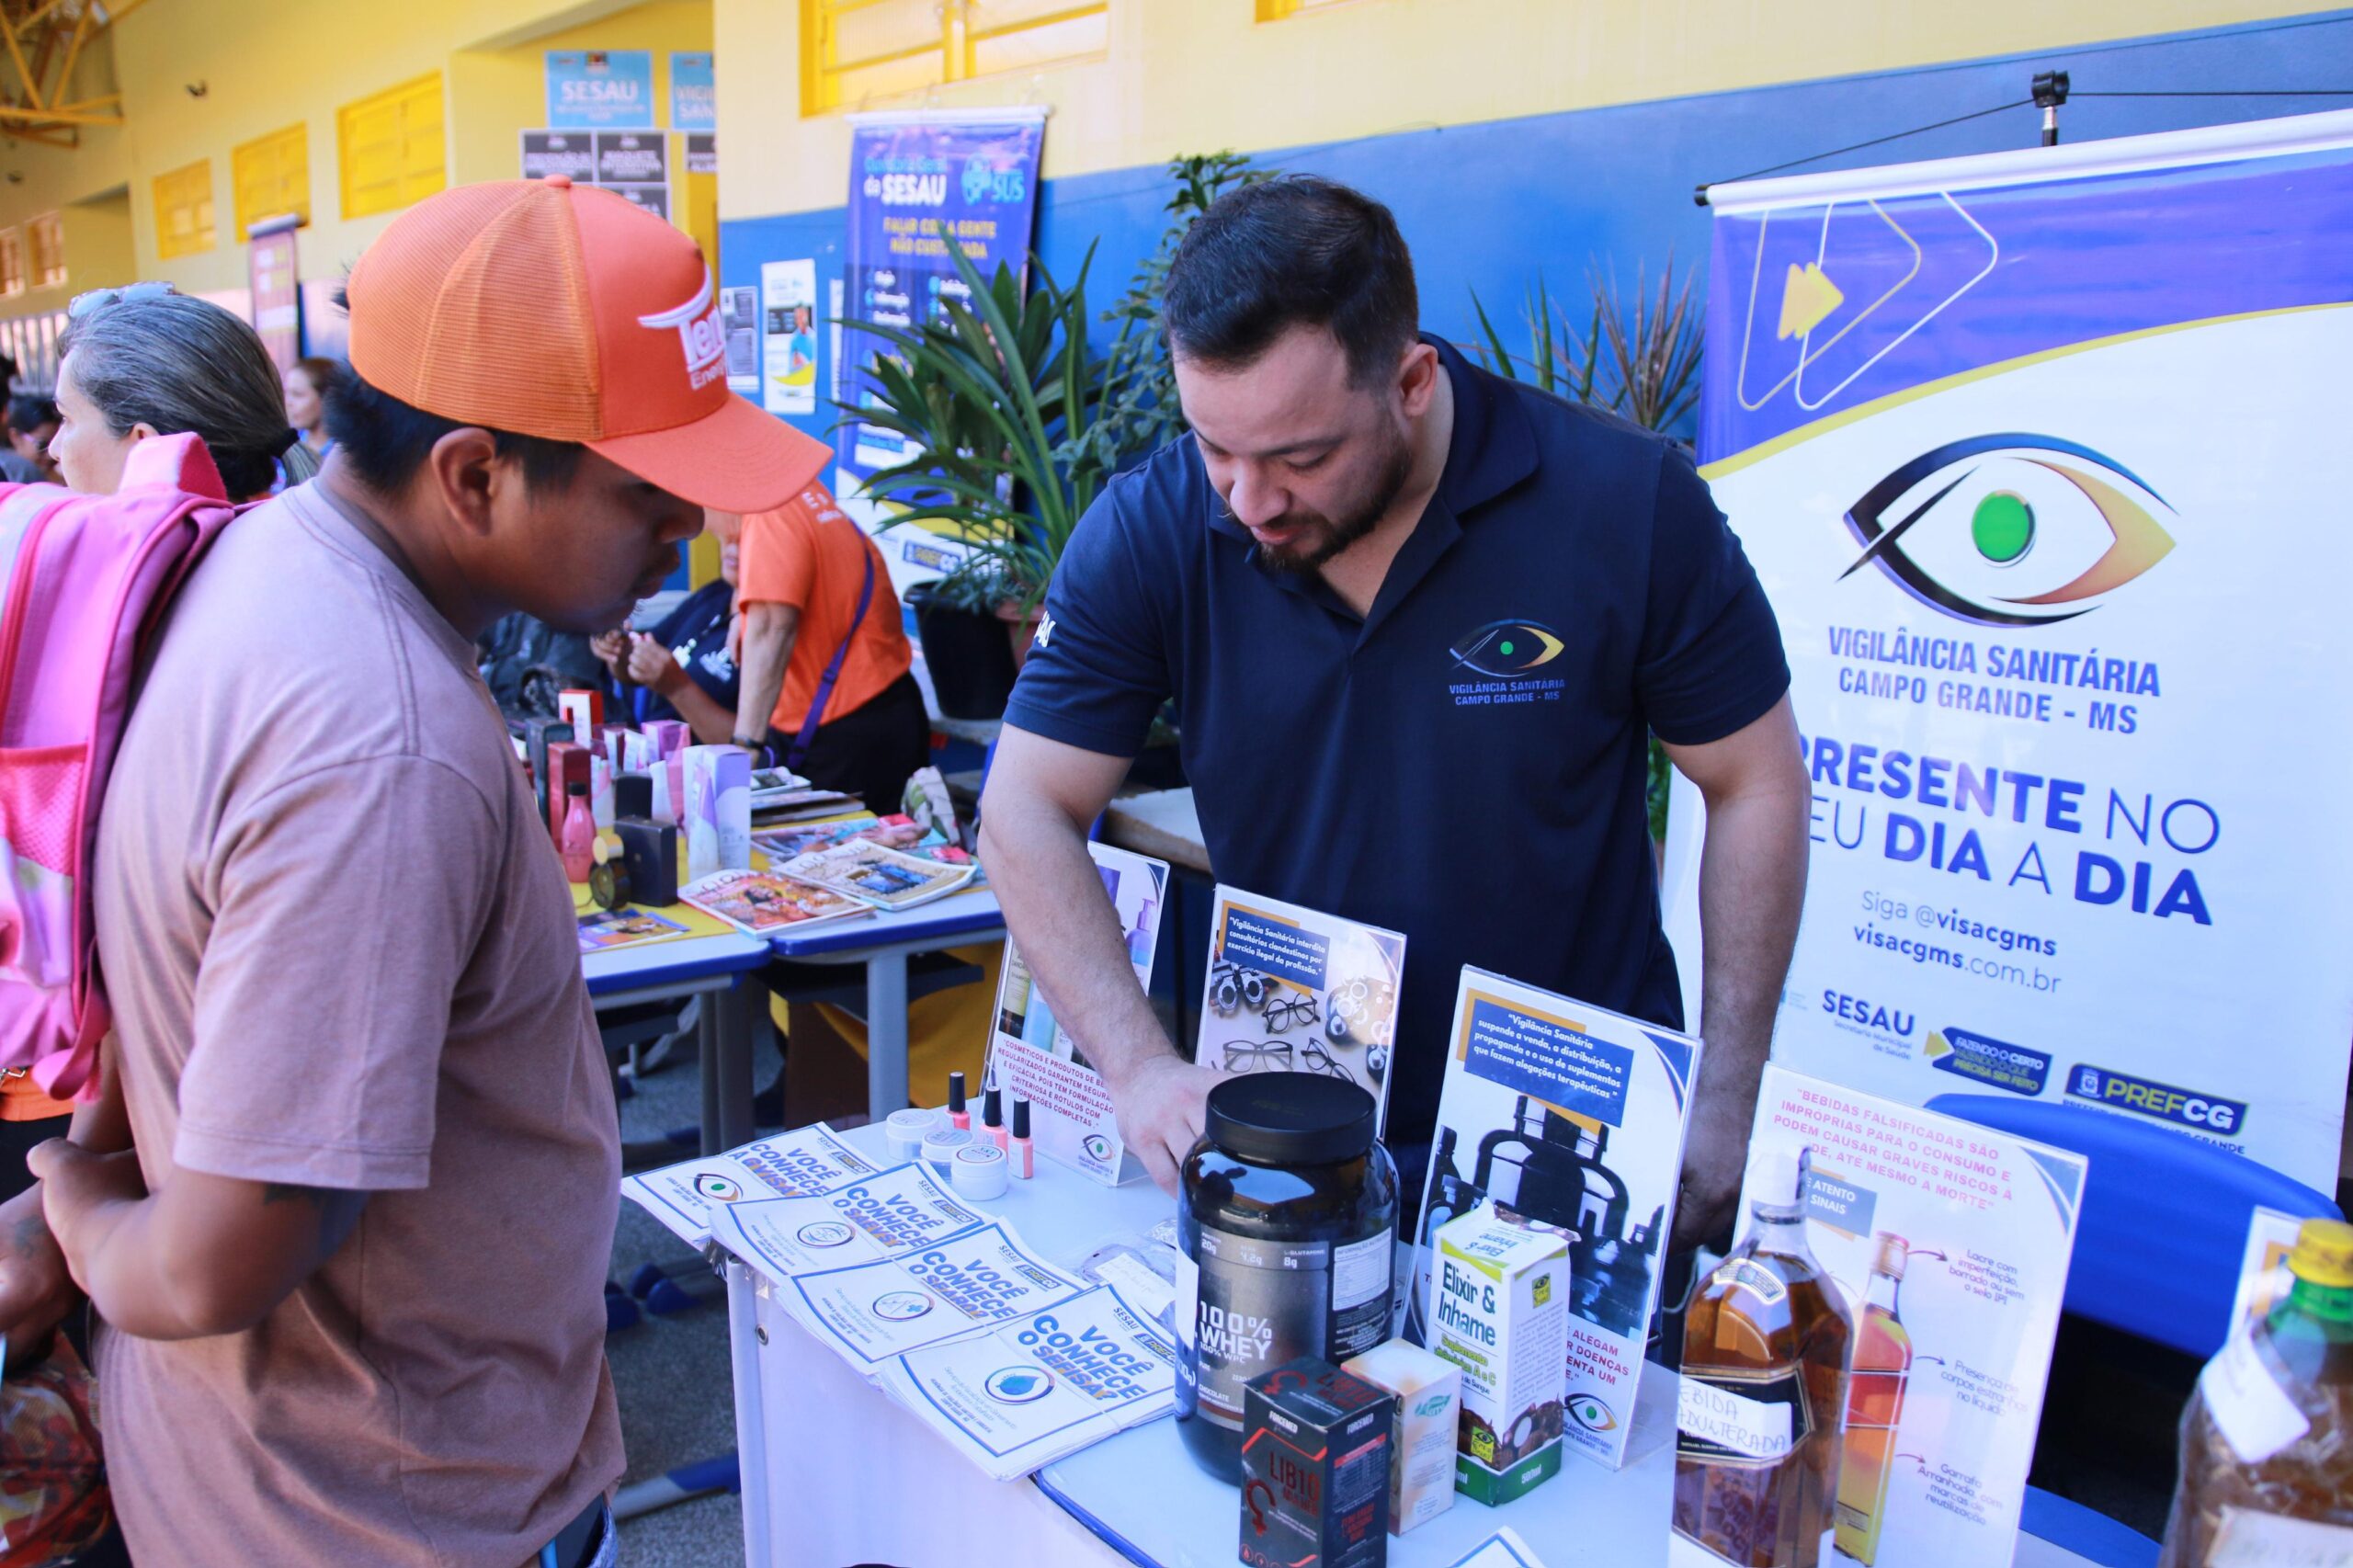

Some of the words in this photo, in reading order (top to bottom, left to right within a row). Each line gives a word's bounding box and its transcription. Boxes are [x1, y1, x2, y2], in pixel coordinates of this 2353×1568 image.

[562, 80, 638, 101] SESAU
[864, 176, 881, 197] da
[881, 174, 947, 206] SESAU
[957, 221, 996, 237] GENTE
[1829, 626, 1978, 675] VIGILÂNCIA
[1987, 644, 2161, 698] SANITÁRIA
[1449, 681, 1506, 694] VIGILÂNCIA
[1510, 678, 1565, 691] SANITÁRIA
[1455, 696, 1490, 705] CAMPO
[1494, 693, 1533, 702] GRANDE
[1544, 691, 1560, 700] MS
[1839, 667, 1927, 704] CAMPO
[1938, 681, 2052, 722] GRANDE
[2088, 701, 2138, 734] MS
[2107, 789, 2220, 854] NO
[1884, 812, 1991, 881] DIA
[2008, 841, 2052, 895] A
[2075, 851, 2212, 926] DIA
[1862, 891, 1907, 920] Siga
[1916, 905, 2057, 956] @visacgms
[1227, 941, 1255, 955] exercício
[1256, 949, 1275, 961] ilegal
[1276, 955, 1284, 964] da
[1230, 931, 1267, 948] consultórios
[1268, 941, 1309, 960] clandestinos
[1265, 928, 1295, 944] Sanitária
[1297, 937, 1325, 953] interdita
[1854, 923, 2062, 993] visacgms.com.br
[1822, 990, 1915, 1037] SESAU
[1478, 1019, 1515, 1038] suspende
[1523, 1034, 1551, 1050] venda,
[1561, 1046, 1613, 1072] distribuição,
[1554, 1029, 1593, 1050] Sanitária
[1834, 1019, 1871, 1038] Secretaria
[1873, 1030, 1912, 1050] Municipal
[1474, 1032, 1523, 1054] propaganda
[1540, 1054, 1553, 1064] uso
[1555, 1059, 1565, 1069] de
[1568, 1063, 1621, 1088] suplementos
[1474, 1046, 1488, 1055] que
[1490, 1049, 1515, 1064] fazem
[1516, 1059, 1556, 1080] alegações
[1885, 1046, 1911, 1060] Saúde
[2010, 1052, 2044, 1070] CERTO
[998, 1048, 1046, 1074] REGULARIZADOS
[1048, 1070, 1082, 1089] GARANTEM
[1039, 1075, 1052, 1088] POIS
[1051, 1060, 1084, 1079] PRODUTOS
[1993, 1069, 2010, 1082] SER
[2011, 1075, 2039, 1091] FEITO
[1011, 1074, 1047, 1096] CRITERIOSA
[1086, 1108, 1101, 1119] COM
[2105, 1078, 2234, 1129] PREFCG
[1054, 1104, 1092, 1128] COMPLETAS
[1863, 1110, 1964, 1150] FALSIFICADAS
[1969, 1142, 1999, 1160] SÃO
[788, 1148, 842, 1180] VOCÊ
[1774, 1115, 1820, 1137] PODEM
[1823, 1131, 1878, 1156] CAUSAR
[1881, 1149, 1939, 1176] GRAVES
[1943, 1171, 1998, 1195] RISCOS
[1836, 1150, 1863, 1168] ATÉ
[1866, 1160, 1917, 1187] MESMO
[1866, 1127, 1904, 1148] PARA
[1908, 1141, 1918, 1152] O
[1923, 1144, 1997, 1177] CONSUMO
[2001, 1170, 2011, 1182] E
[750, 1143, 831, 1197] CONHECE
[1813, 1176, 1857, 1202] ATENTO
[833, 1199, 851, 1208] O
[847, 1187, 932, 1247] CONHECE
[886, 1193, 945, 1231] VOCÊ
[1810, 1193, 1847, 1215] SINAIS
[1201, 1240, 1216, 1255] 20g
[1967, 1249, 1994, 1266] Lacre
[1997, 1262, 2018, 1274] com
[908, 1264, 928, 1275] O
[1284, 1257, 1297, 1268] 8g
[922, 1251, 1018, 1319] CONHECE
[965, 1258, 1029, 1300] VOCÊ
[1443, 1260, 1478, 1304] Elixir
[1483, 1284, 1495, 1314] &
[1949, 1265, 1988, 1286] borrado
[1991, 1282, 2002, 1291] ou
[2005, 1288, 2025, 1301] sem
[1973, 1287, 1992, 1299] selo
[1113, 1306, 1140, 1330] SESAU
[1200, 1300, 1272, 1340] 100%
[1438, 1290, 1495, 1346] Inhame
[1017, 1330, 1040, 1346] O
[1079, 1324, 1154, 1376] VOCÊ
[1200, 1322, 1272, 1360] WHEY
[1573, 1329, 1619, 1357] ALEGAM
[1034, 1314, 1148, 1399] CONHECE
[1200, 1341, 1221, 1357] 100%
[1223, 1352, 1245, 1364] WPC
[1473, 1364, 1481, 1379] A
[1488, 1371, 1496, 1386] C
[1598, 1370, 1616, 1385] UM
[1941, 1371, 1974, 1391] corpos
[1199, 1383, 1230, 1402] CHOCOLATE
[1957, 1392, 1970, 1403] no
[1268, 1410, 1299, 1434] FORCEMED
[1941, 1463, 1983, 1489] Garrafa
[1930, 1484, 1968, 1506] marcas
